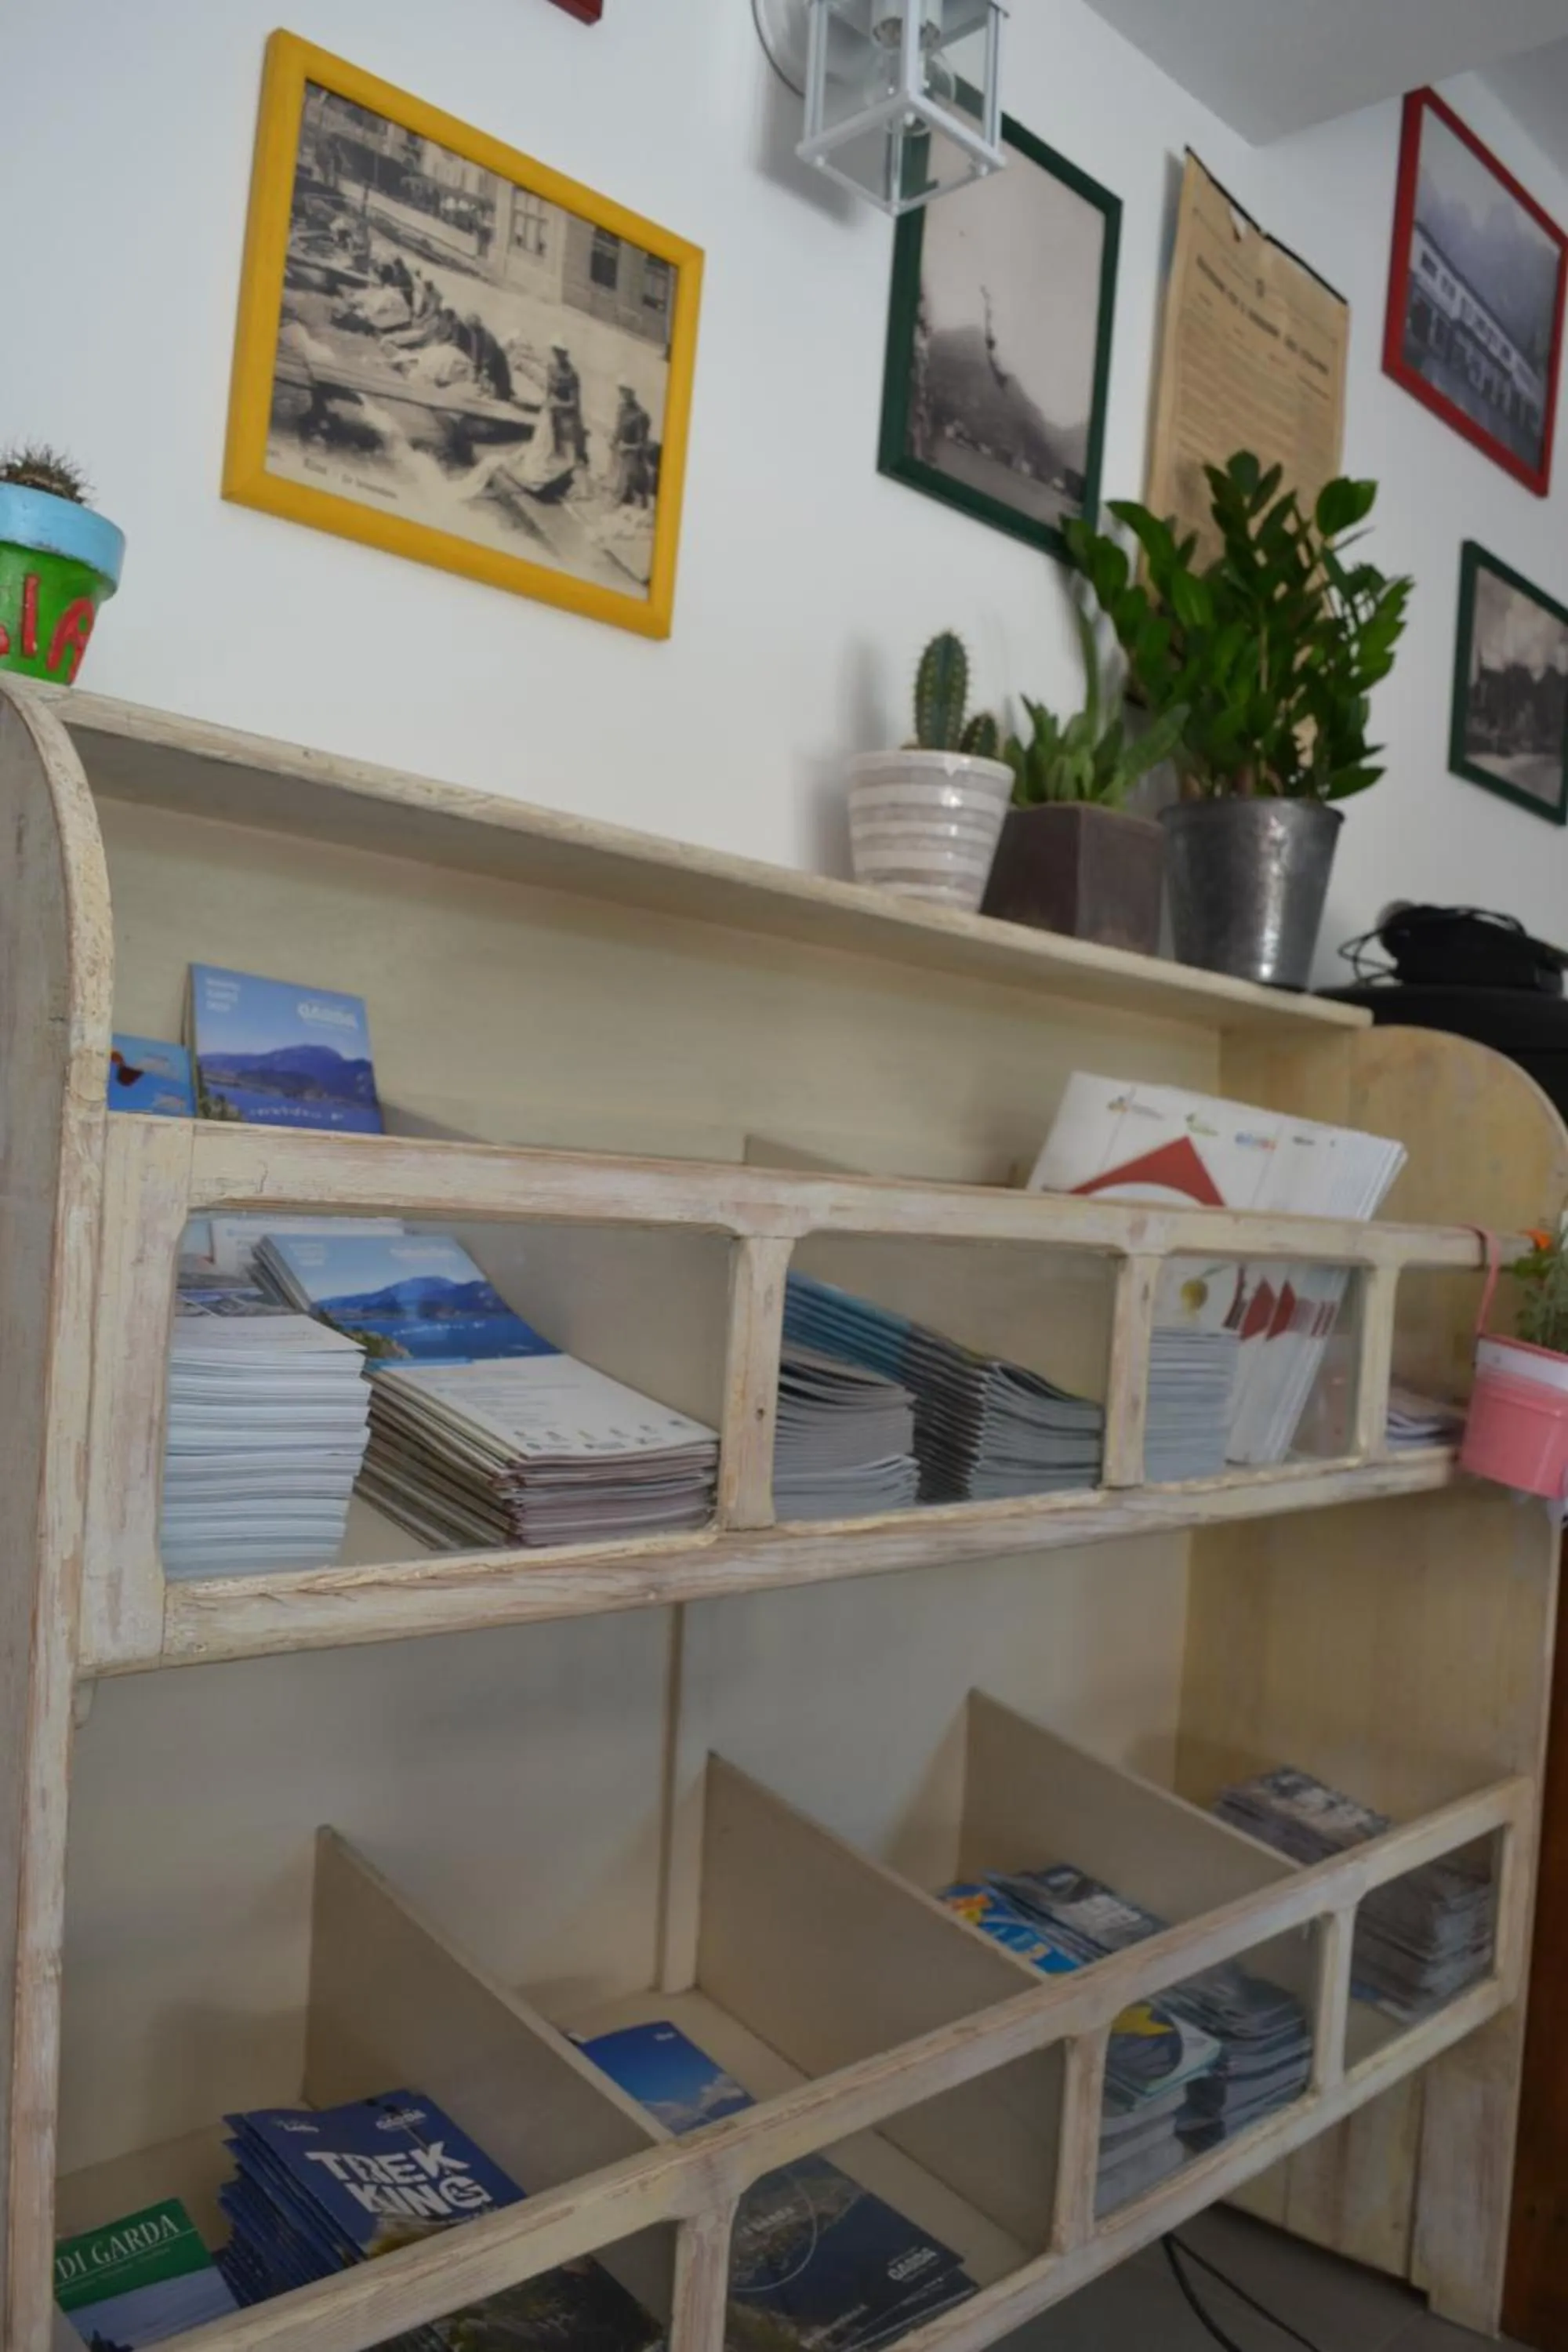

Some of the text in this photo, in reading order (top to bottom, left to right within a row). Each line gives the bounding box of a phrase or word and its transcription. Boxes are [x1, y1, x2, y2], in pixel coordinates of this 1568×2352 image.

[0, 573, 95, 684] IA
[305, 2141, 470, 2182] TREK
[345, 2176, 493, 2216] KING
[56, 2249, 88, 2279] DI
[91, 2214, 180, 2265] GARDA
